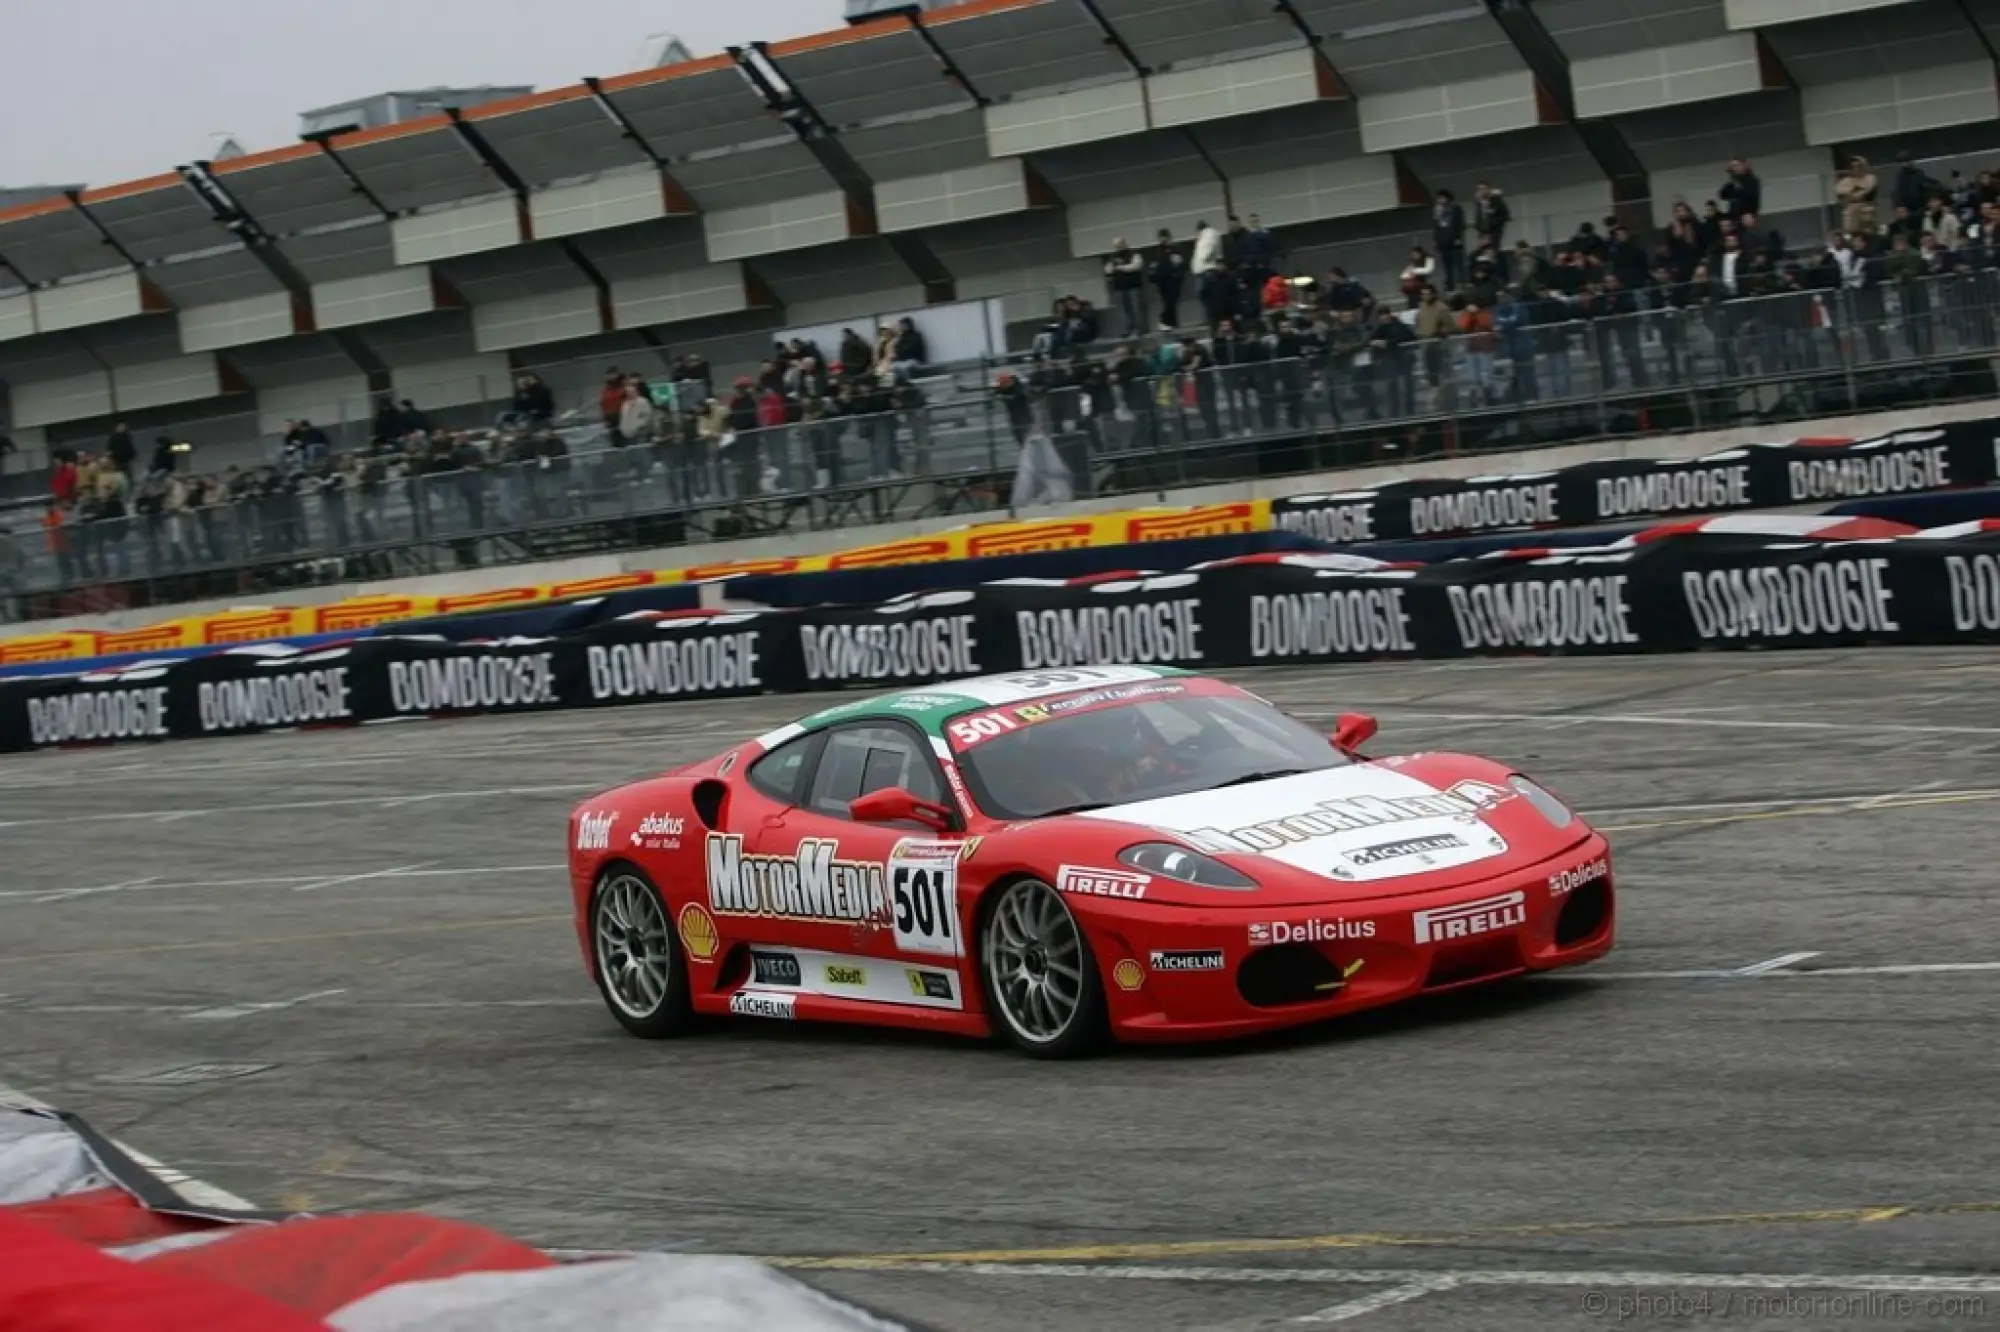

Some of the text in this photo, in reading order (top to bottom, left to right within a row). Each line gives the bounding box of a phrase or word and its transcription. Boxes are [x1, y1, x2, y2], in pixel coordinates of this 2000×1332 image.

[1597, 464, 1751, 517] BOMBOOGIE
[1789, 445, 1951, 500] BOMBOOGIE
[1411, 483, 1561, 535] BOMBOOGIE
[1250, 587, 1416, 658] BOMBOOGIE
[1447, 575, 1639, 647] BOMBOOGIE
[1682, 558, 1899, 638] BOMBOOGIE
[800, 615, 982, 681] BOMBOOGIE
[1016, 598, 1203, 668] BOMBOOGIE
[388, 652, 561, 711] BOMBOOGIE
[588, 631, 762, 699] BOMBOOGIE
[27, 687, 169, 743] BOMBOOGIE
[200, 667, 352, 731] BOMBOOGIE
[950, 713, 1016, 744] 501
[638, 811, 684, 834] abakus
[893, 866, 951, 938] 501
[1056, 864, 1151, 899] PIRELLI
[1561, 859, 1607, 892] Delicius
[1272, 917, 1376, 943] Delicius
[1412, 890, 1526, 945] PIRELLI
[755, 958, 798, 978] IVECO
[827, 966, 862, 985] Sabelt
